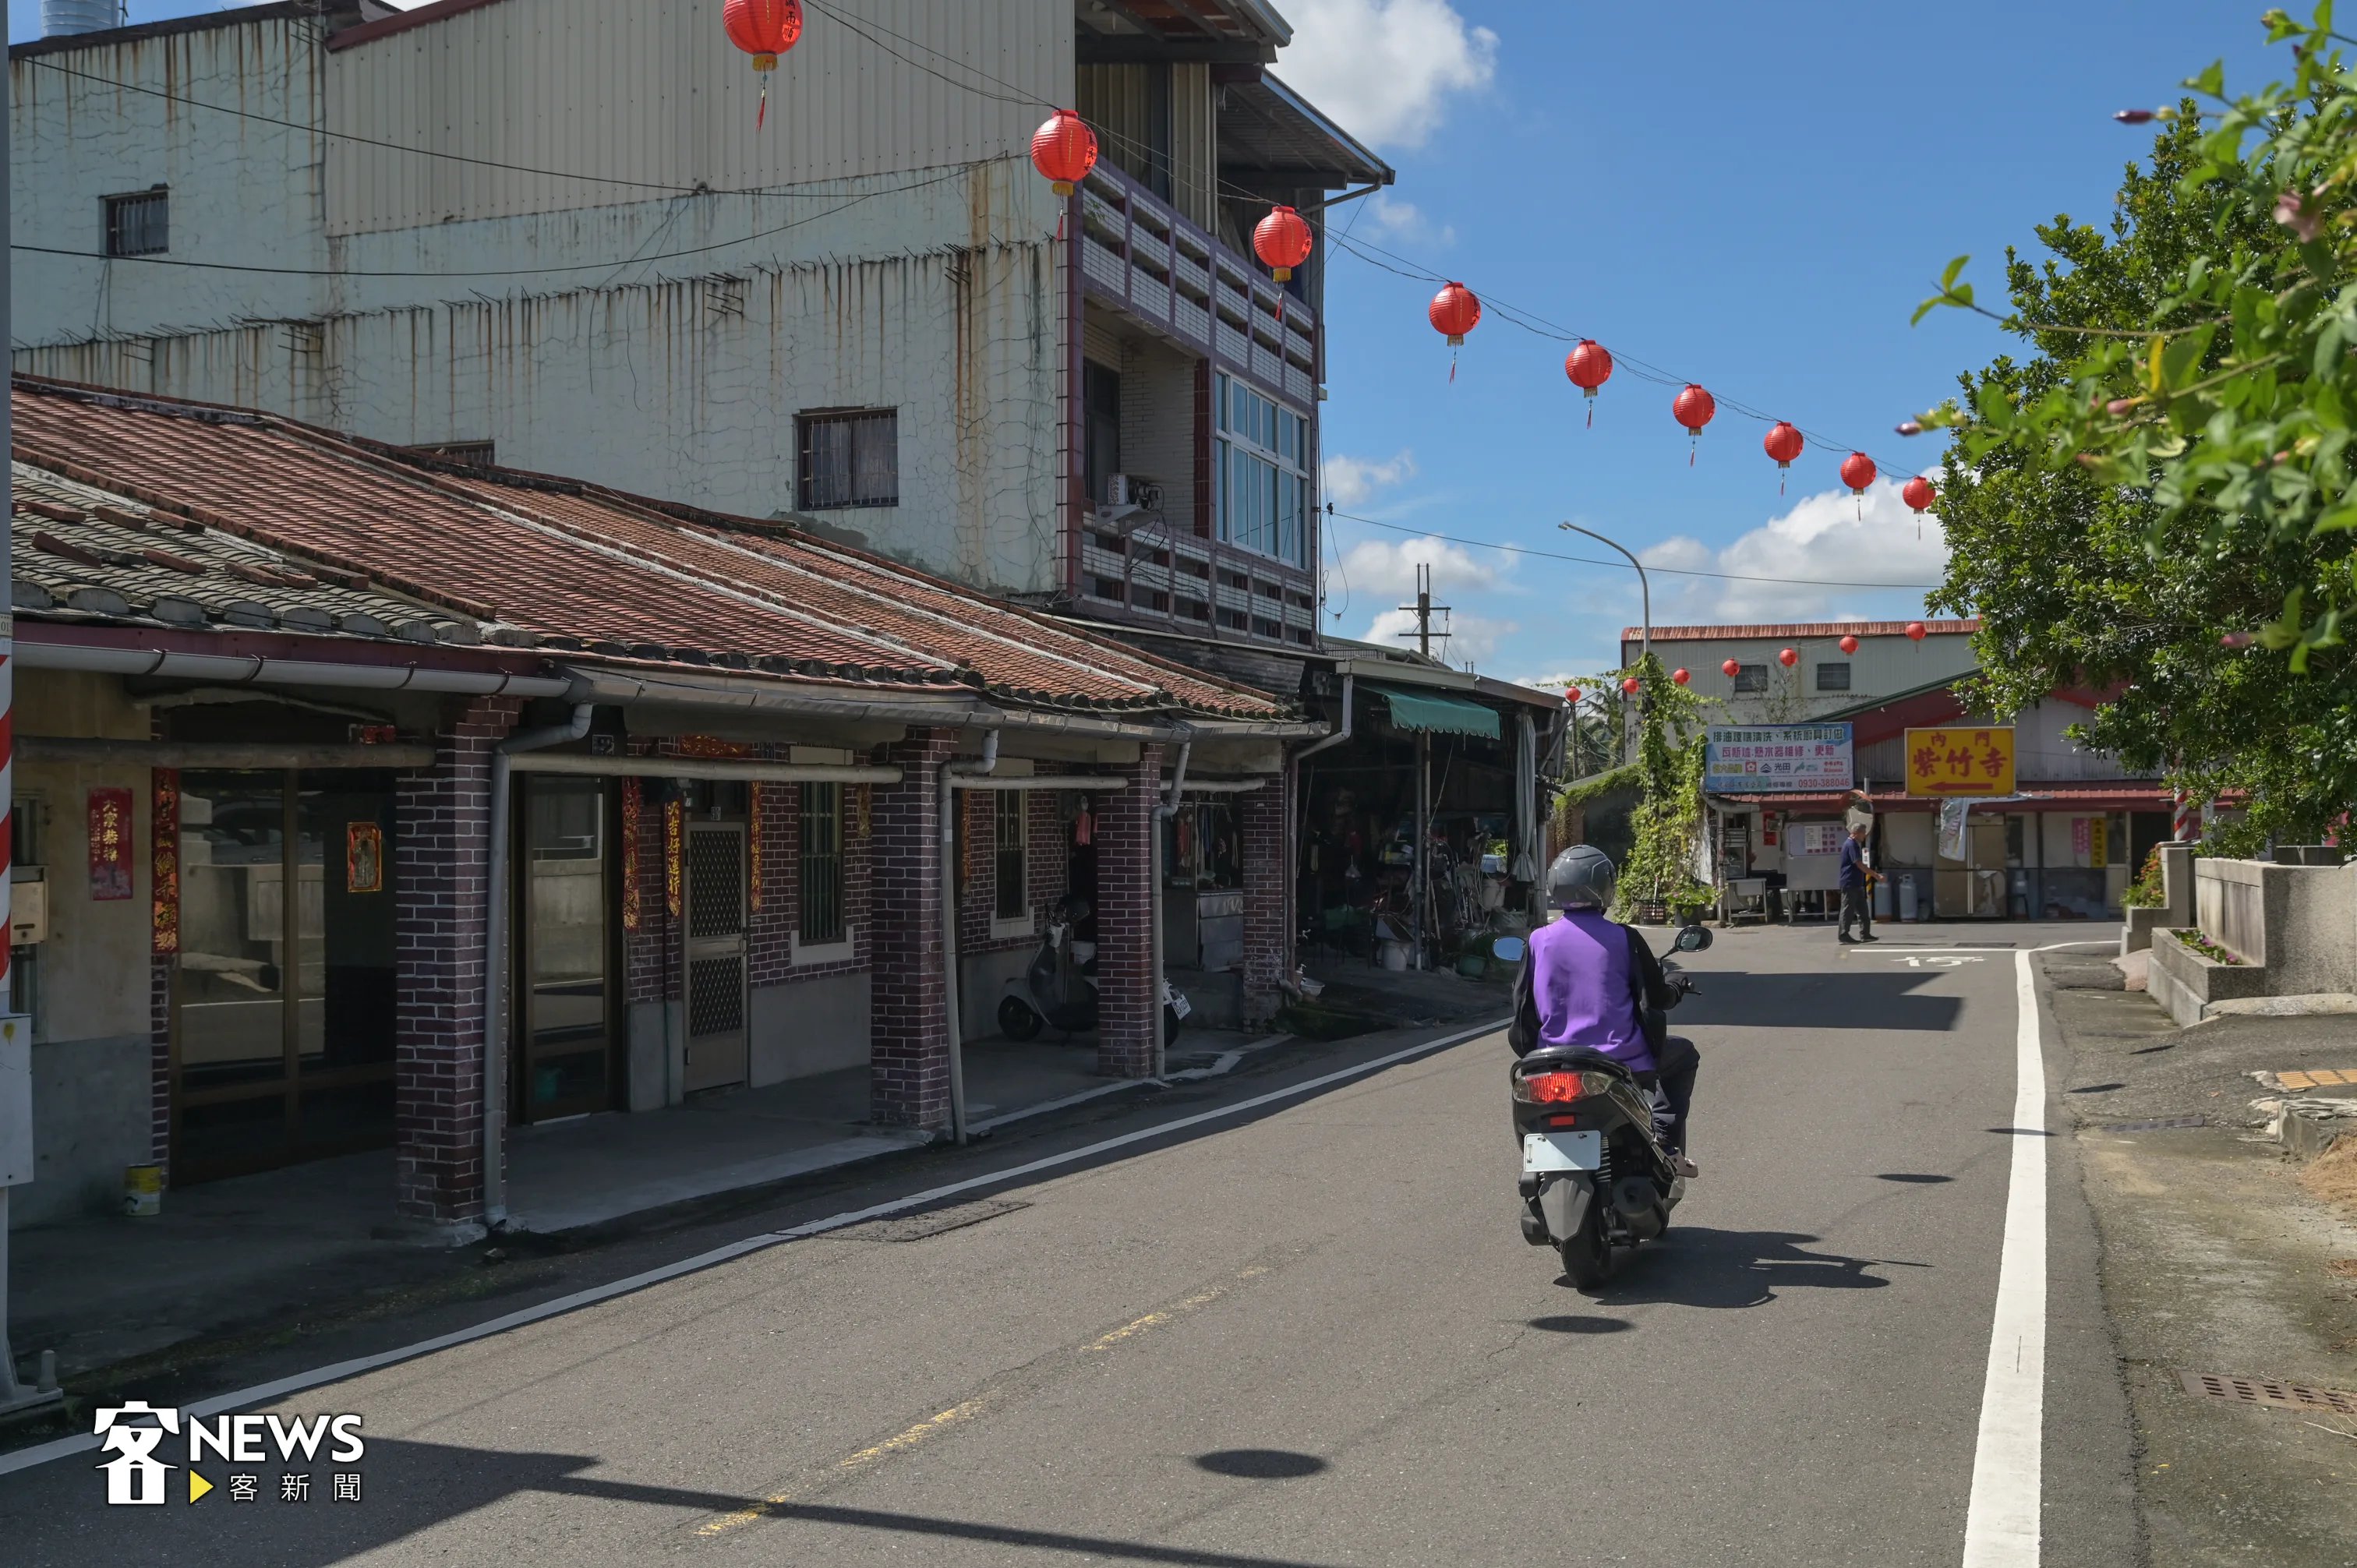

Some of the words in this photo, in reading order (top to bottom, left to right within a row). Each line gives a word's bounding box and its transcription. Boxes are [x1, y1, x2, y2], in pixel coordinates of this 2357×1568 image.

[1931, 731, 1990, 747] 內門
[1913, 747, 2009, 778] 紫竹寺
[1797, 779, 1850, 788] 0930-388046
